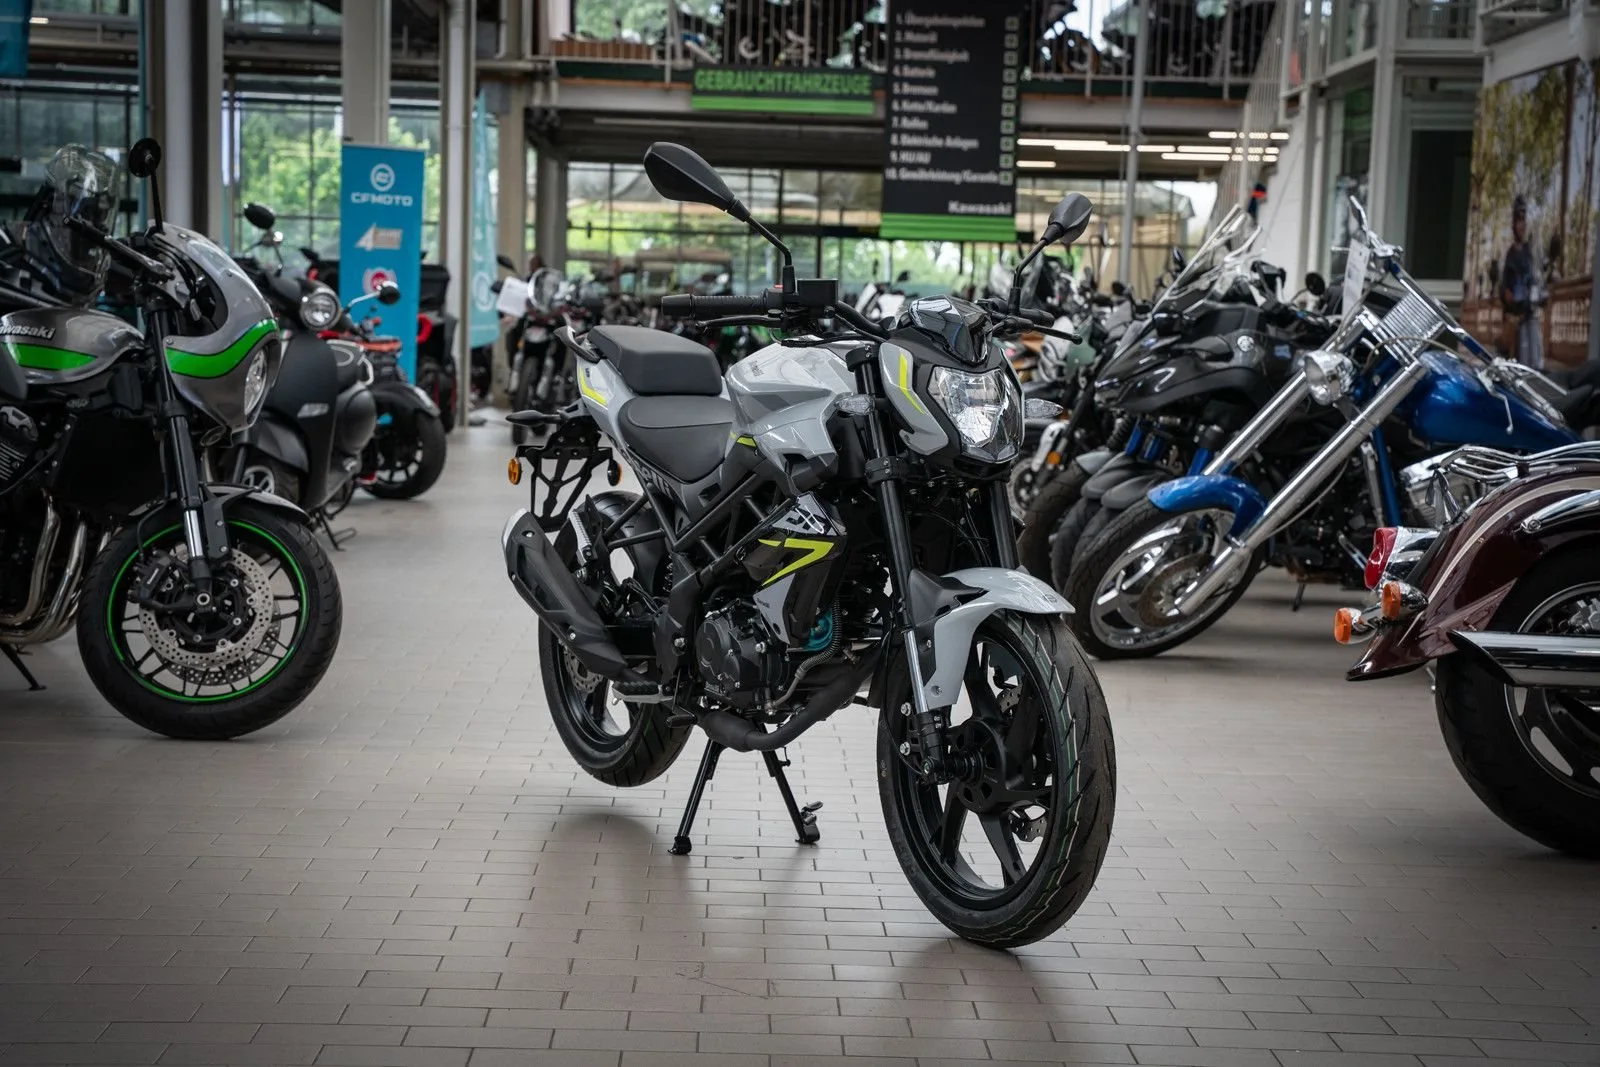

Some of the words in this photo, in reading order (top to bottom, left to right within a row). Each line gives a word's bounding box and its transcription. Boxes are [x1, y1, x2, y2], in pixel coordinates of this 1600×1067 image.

[694, 68, 872, 95] GEBRAUCHTFAHRZEUGE
[351, 192, 413, 207] CFMOTO
[948, 201, 1013, 215] Kawasaki
